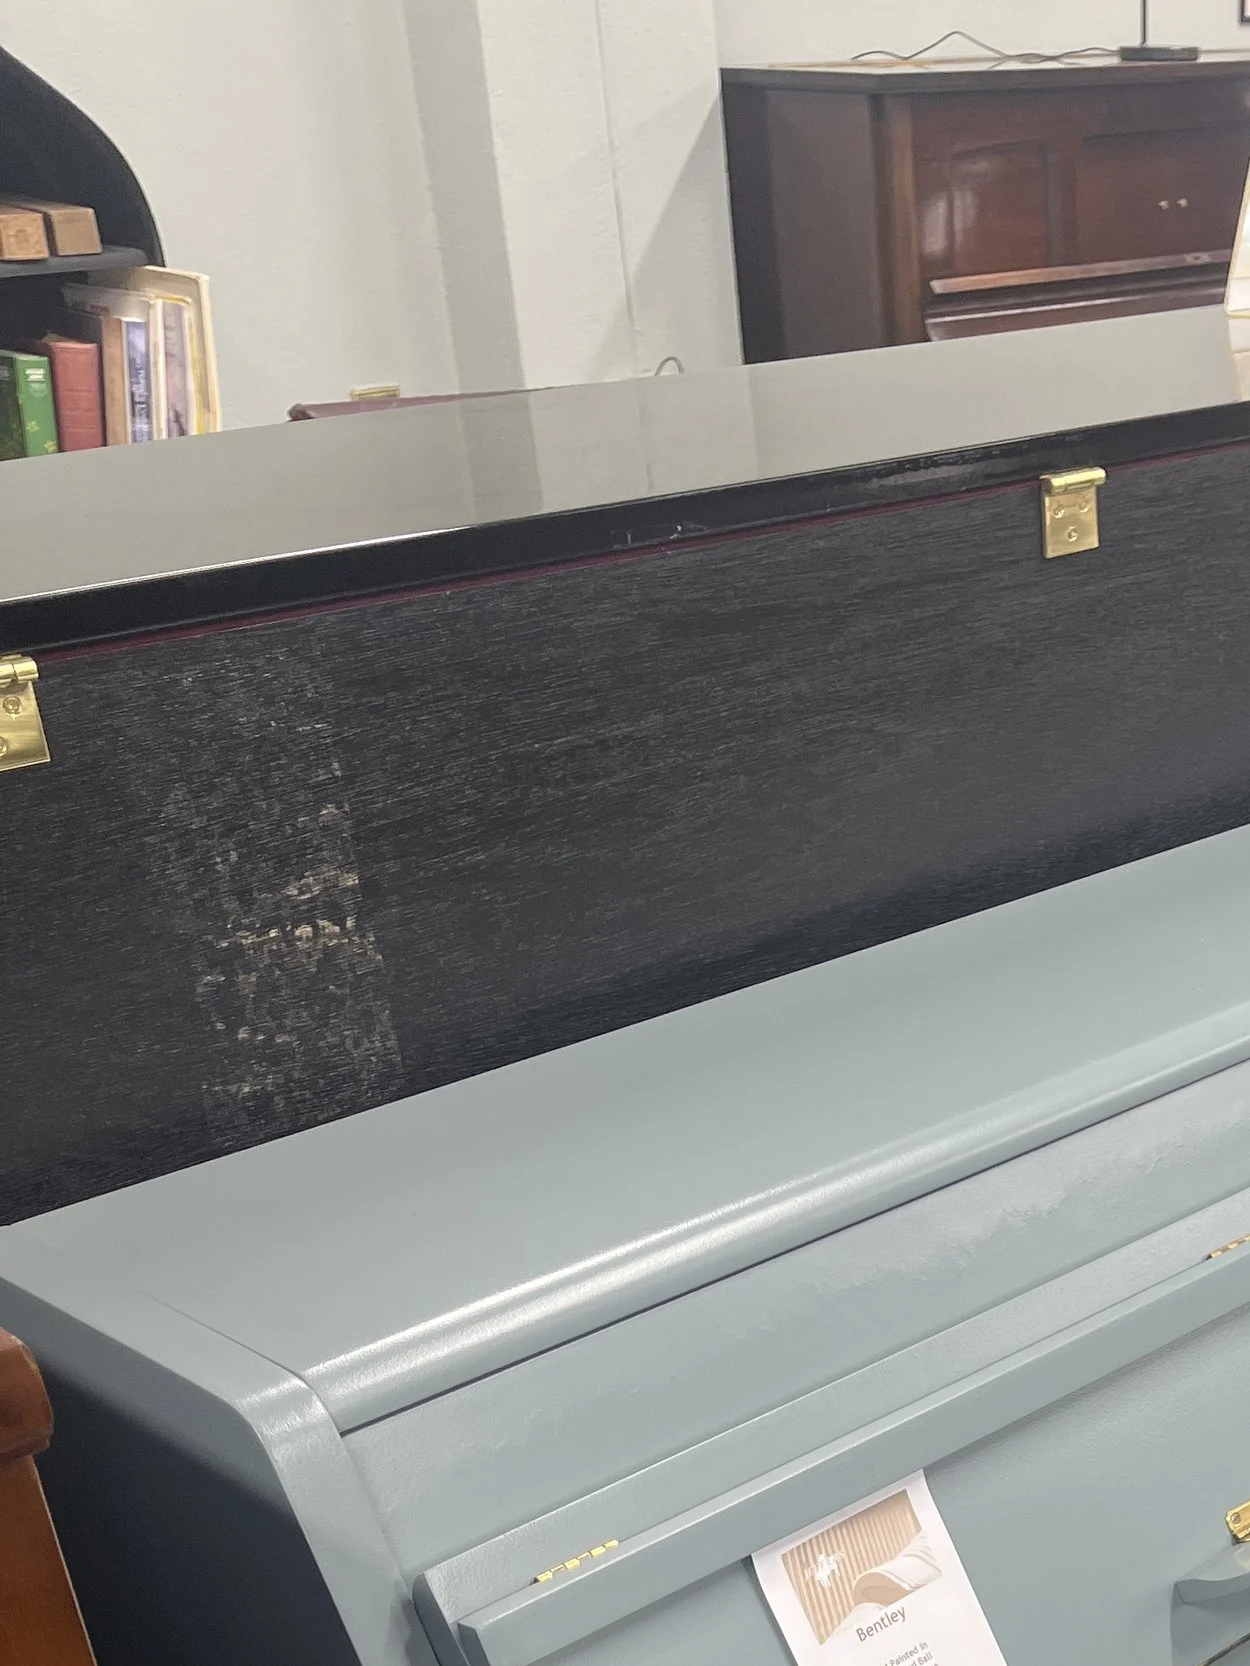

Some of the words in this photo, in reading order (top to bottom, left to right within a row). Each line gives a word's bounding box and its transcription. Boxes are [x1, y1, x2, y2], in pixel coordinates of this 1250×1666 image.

[856, 1606, 906, 1642] Bentley
[919, 1641, 929, 1651] in
[917, 1651, 933, 1666] Ball
